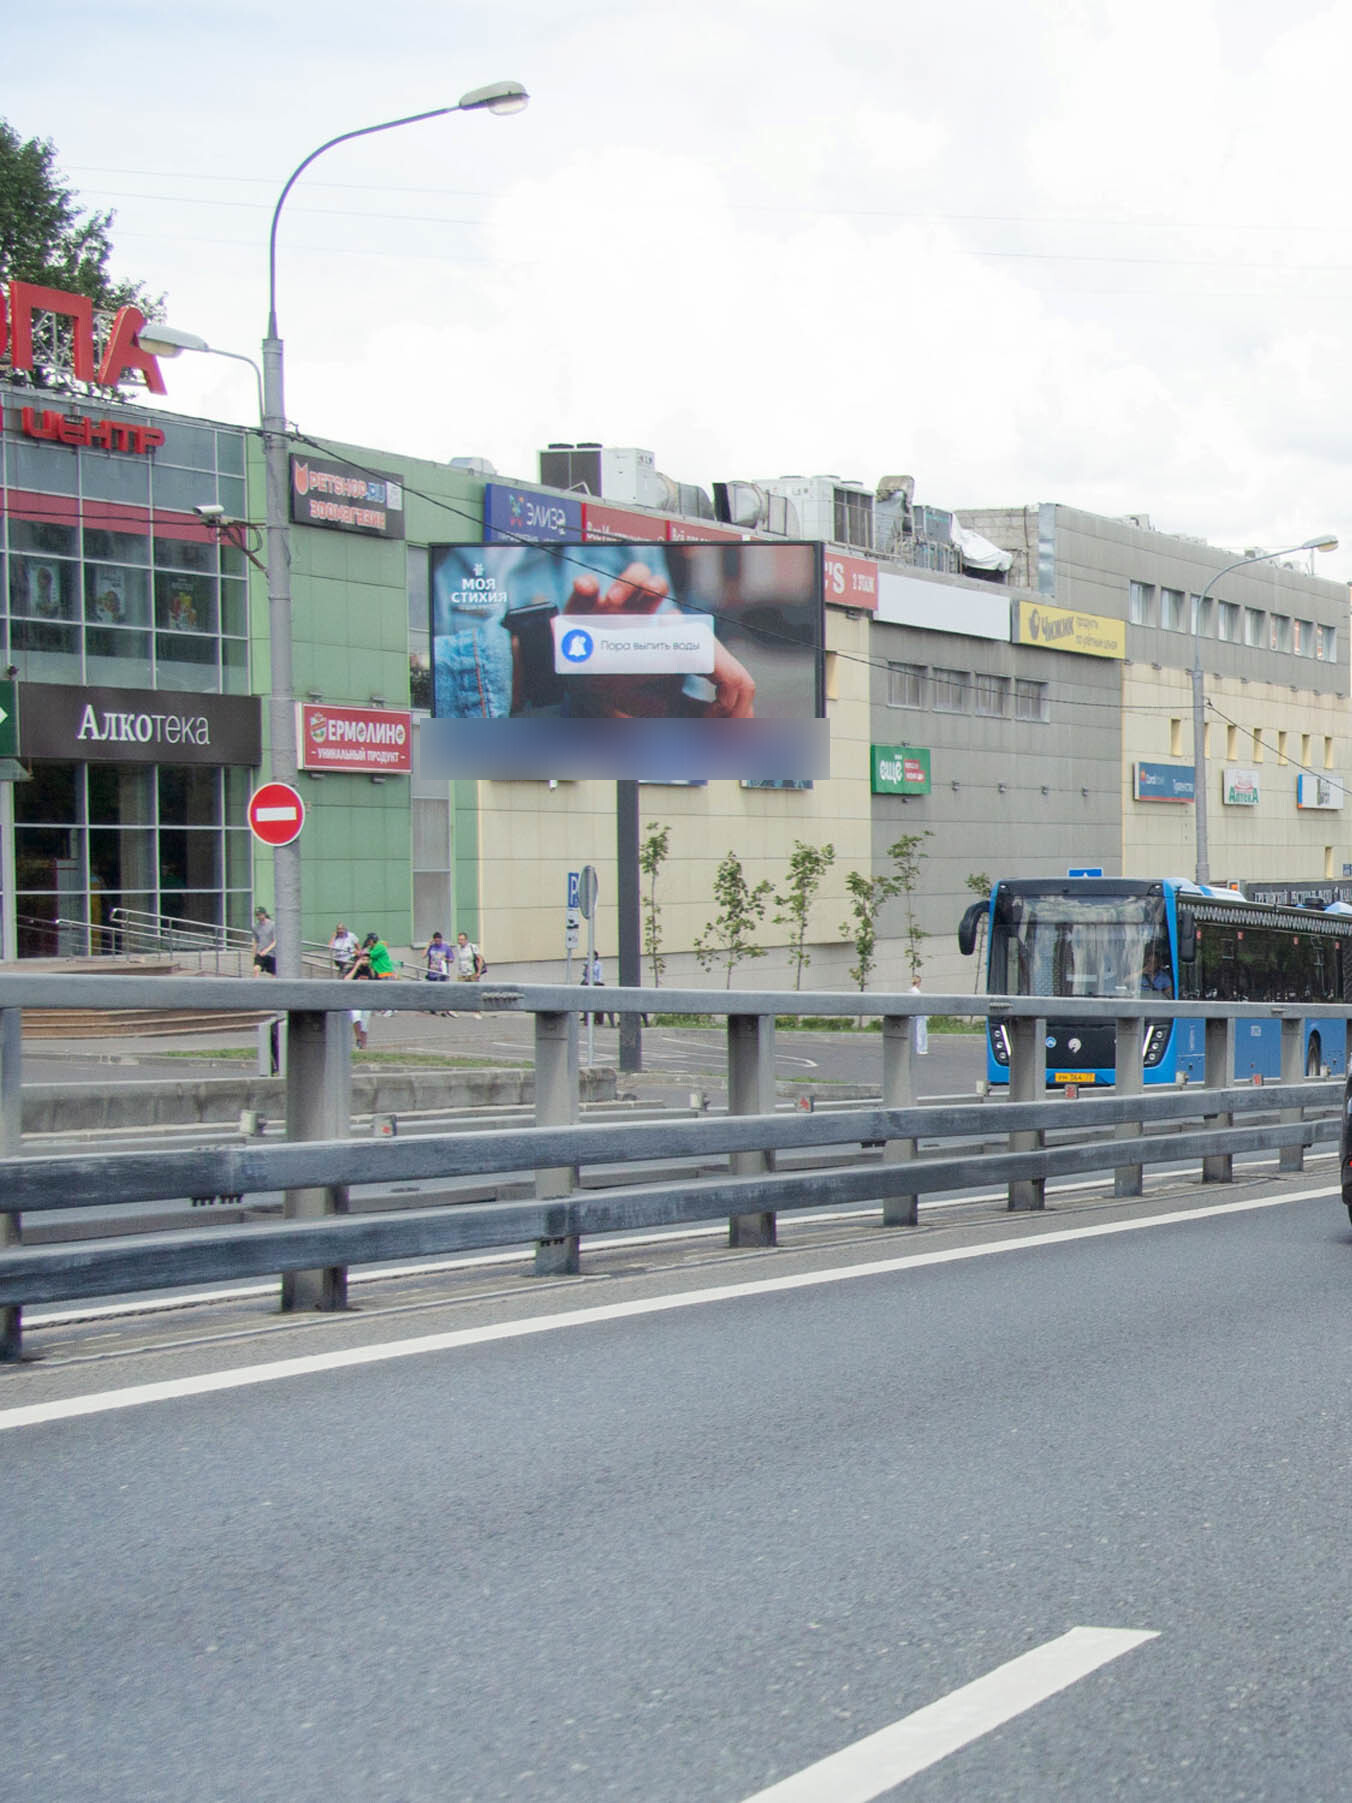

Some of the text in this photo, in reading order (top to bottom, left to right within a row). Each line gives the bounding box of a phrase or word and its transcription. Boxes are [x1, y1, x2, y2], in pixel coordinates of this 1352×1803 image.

[0, 281, 168, 396] ПА
[21, 406, 166, 454] ЦЕНТР
[462, 578, 496, 590] МОЯ
[451, 592, 508, 603] СТИХИЯ
[600, 639, 632, 651] Пора
[672, 641, 700, 651] воды
[328, 719, 406, 745] ЕРМОЛИНО
